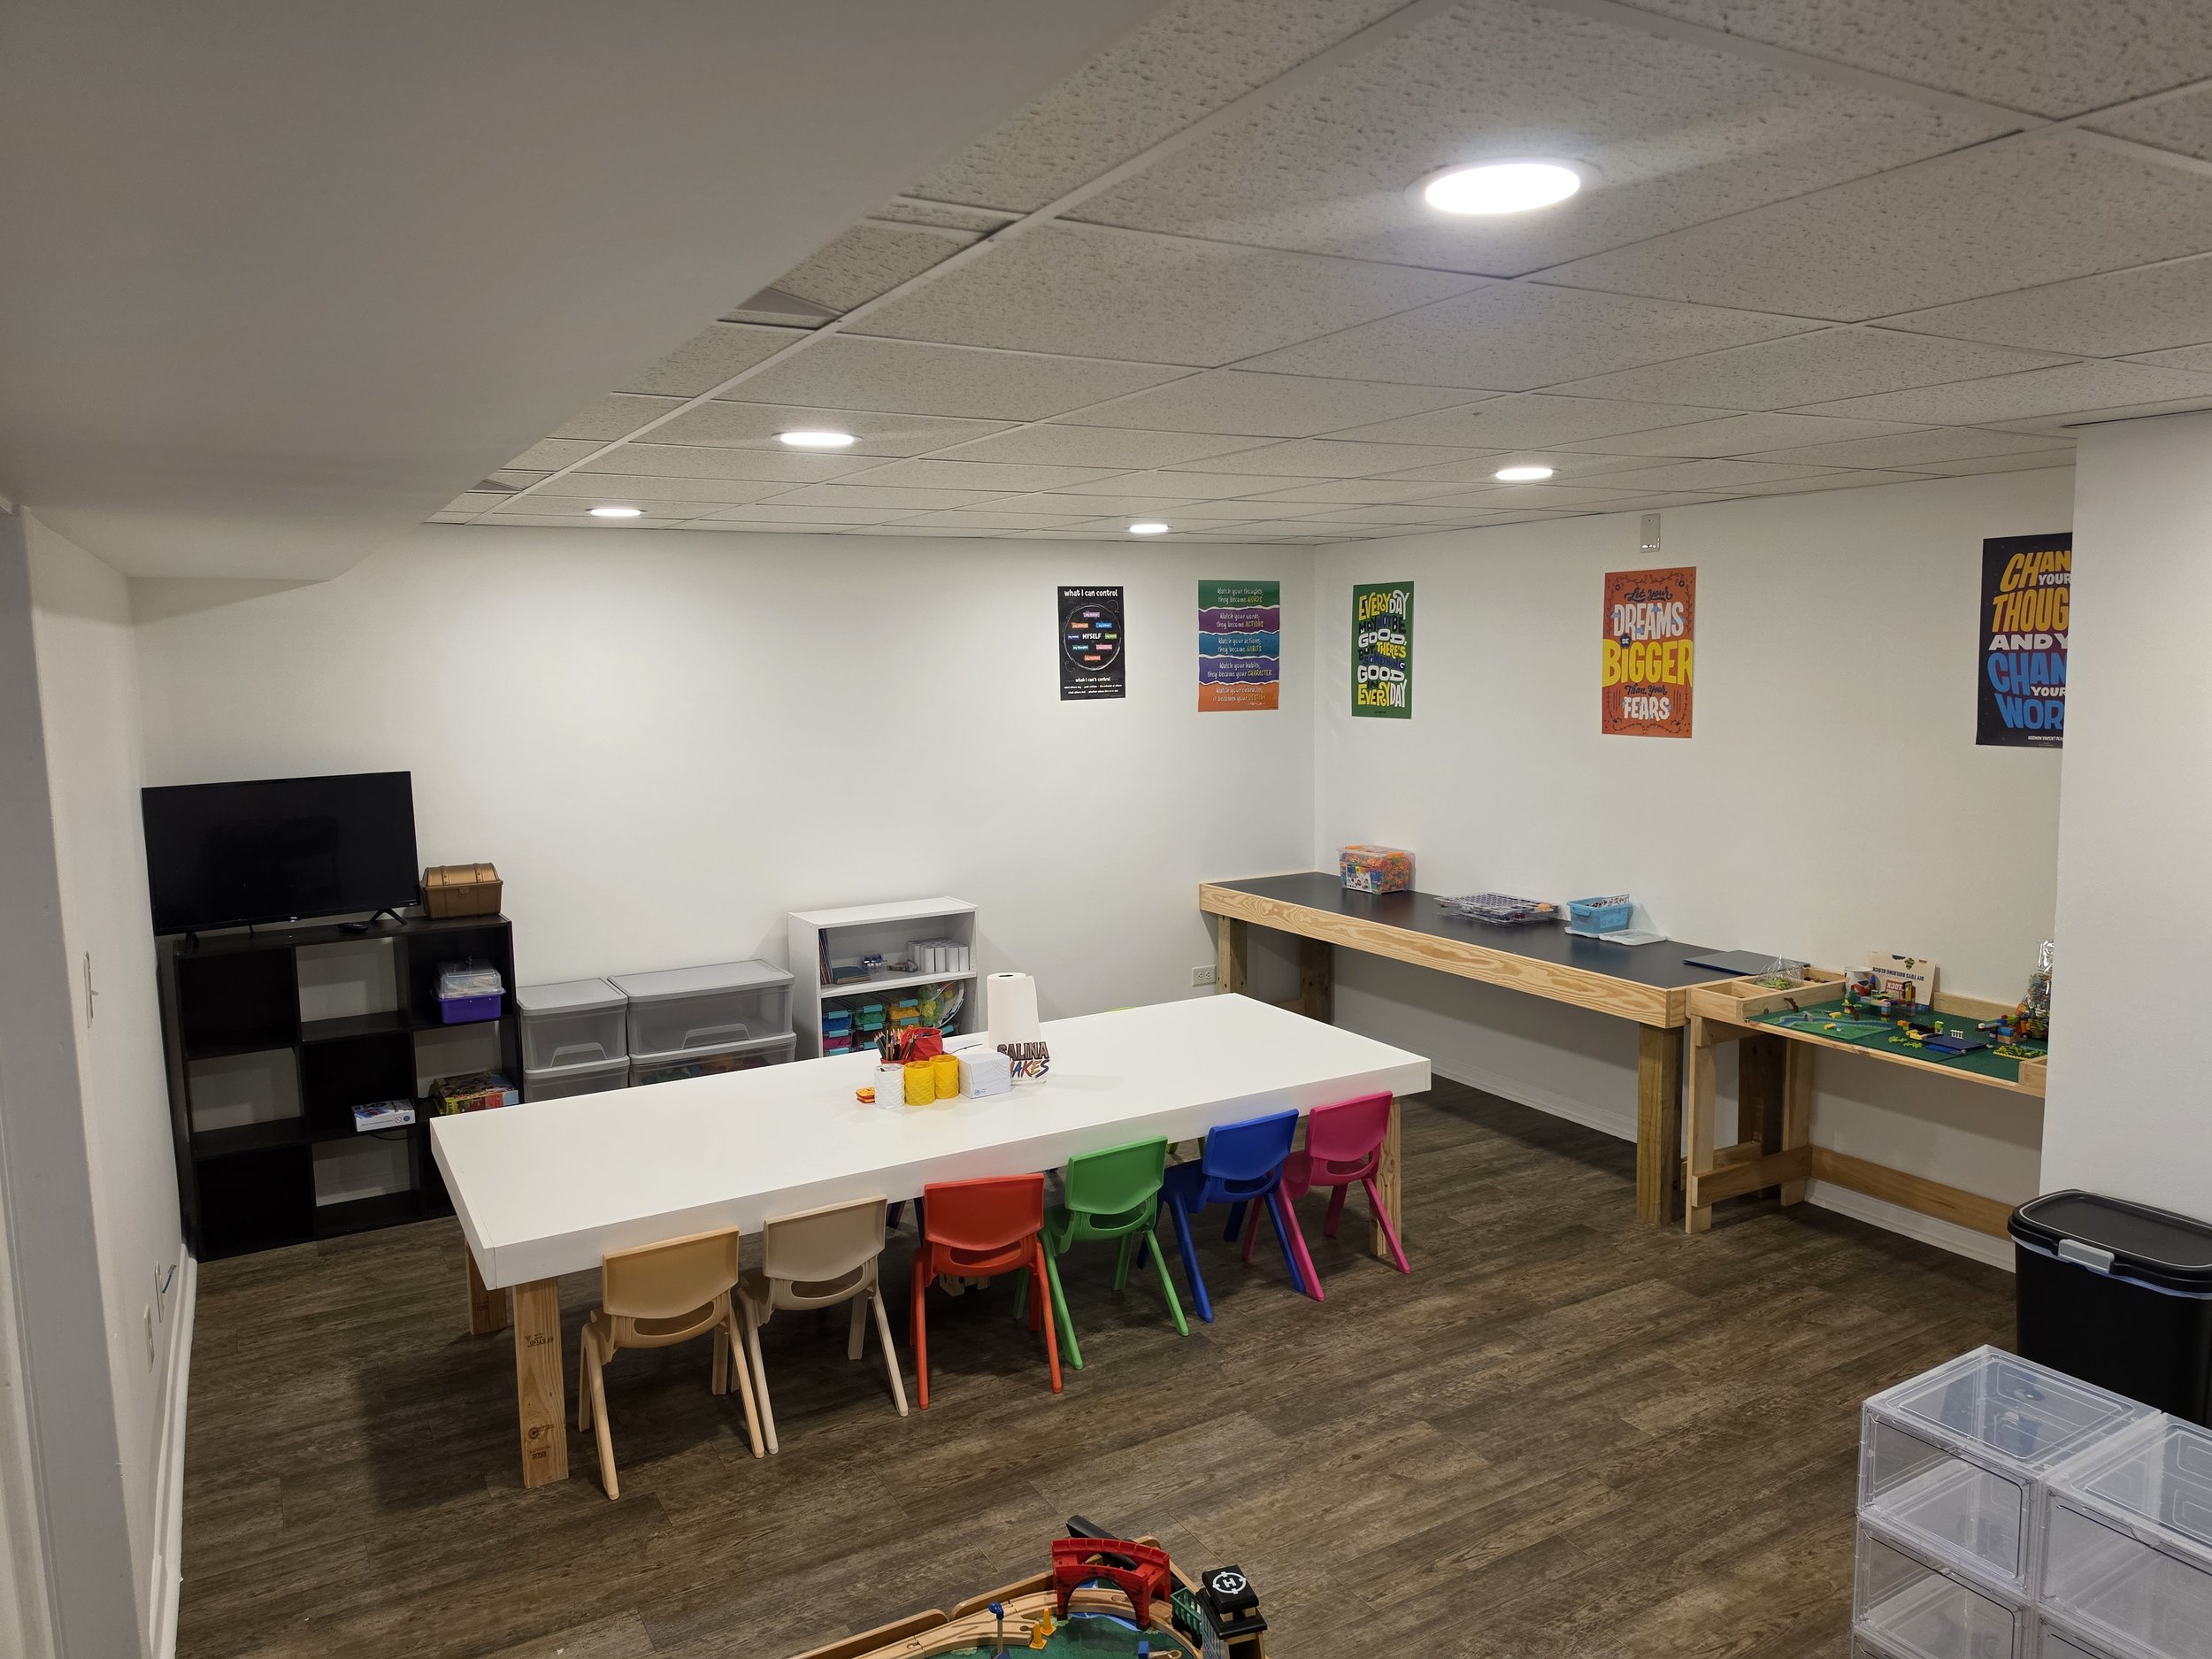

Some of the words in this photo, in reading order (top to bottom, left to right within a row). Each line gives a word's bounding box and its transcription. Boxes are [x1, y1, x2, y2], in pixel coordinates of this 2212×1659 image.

[2000, 550, 2071, 593] CHAN
[2039, 572, 2071, 586] YOUR
[1217, 596, 1228, 605] they
[1992, 587, 2069, 633] THOUG
[1358, 618, 1377, 634] MAY
[1392, 615, 1407, 634] BE
[1613, 601, 1685, 641] DREAMS
[1377, 641, 1407, 659] THERE'S
[1601, 639, 1694, 687] BIGGER
[1207, 671, 1217, 680] they
[1987, 651, 2068, 695] CHAN
[2030, 686, 2066, 697] YOUR
[1623, 696, 1671, 722] FEARS
[1994, 692, 2064, 730] WOR
[1886, 982, 1903, 991] LOCK
[997, 1041, 1050, 1061] SALINA
[1222, 1578, 1237, 1588] H
